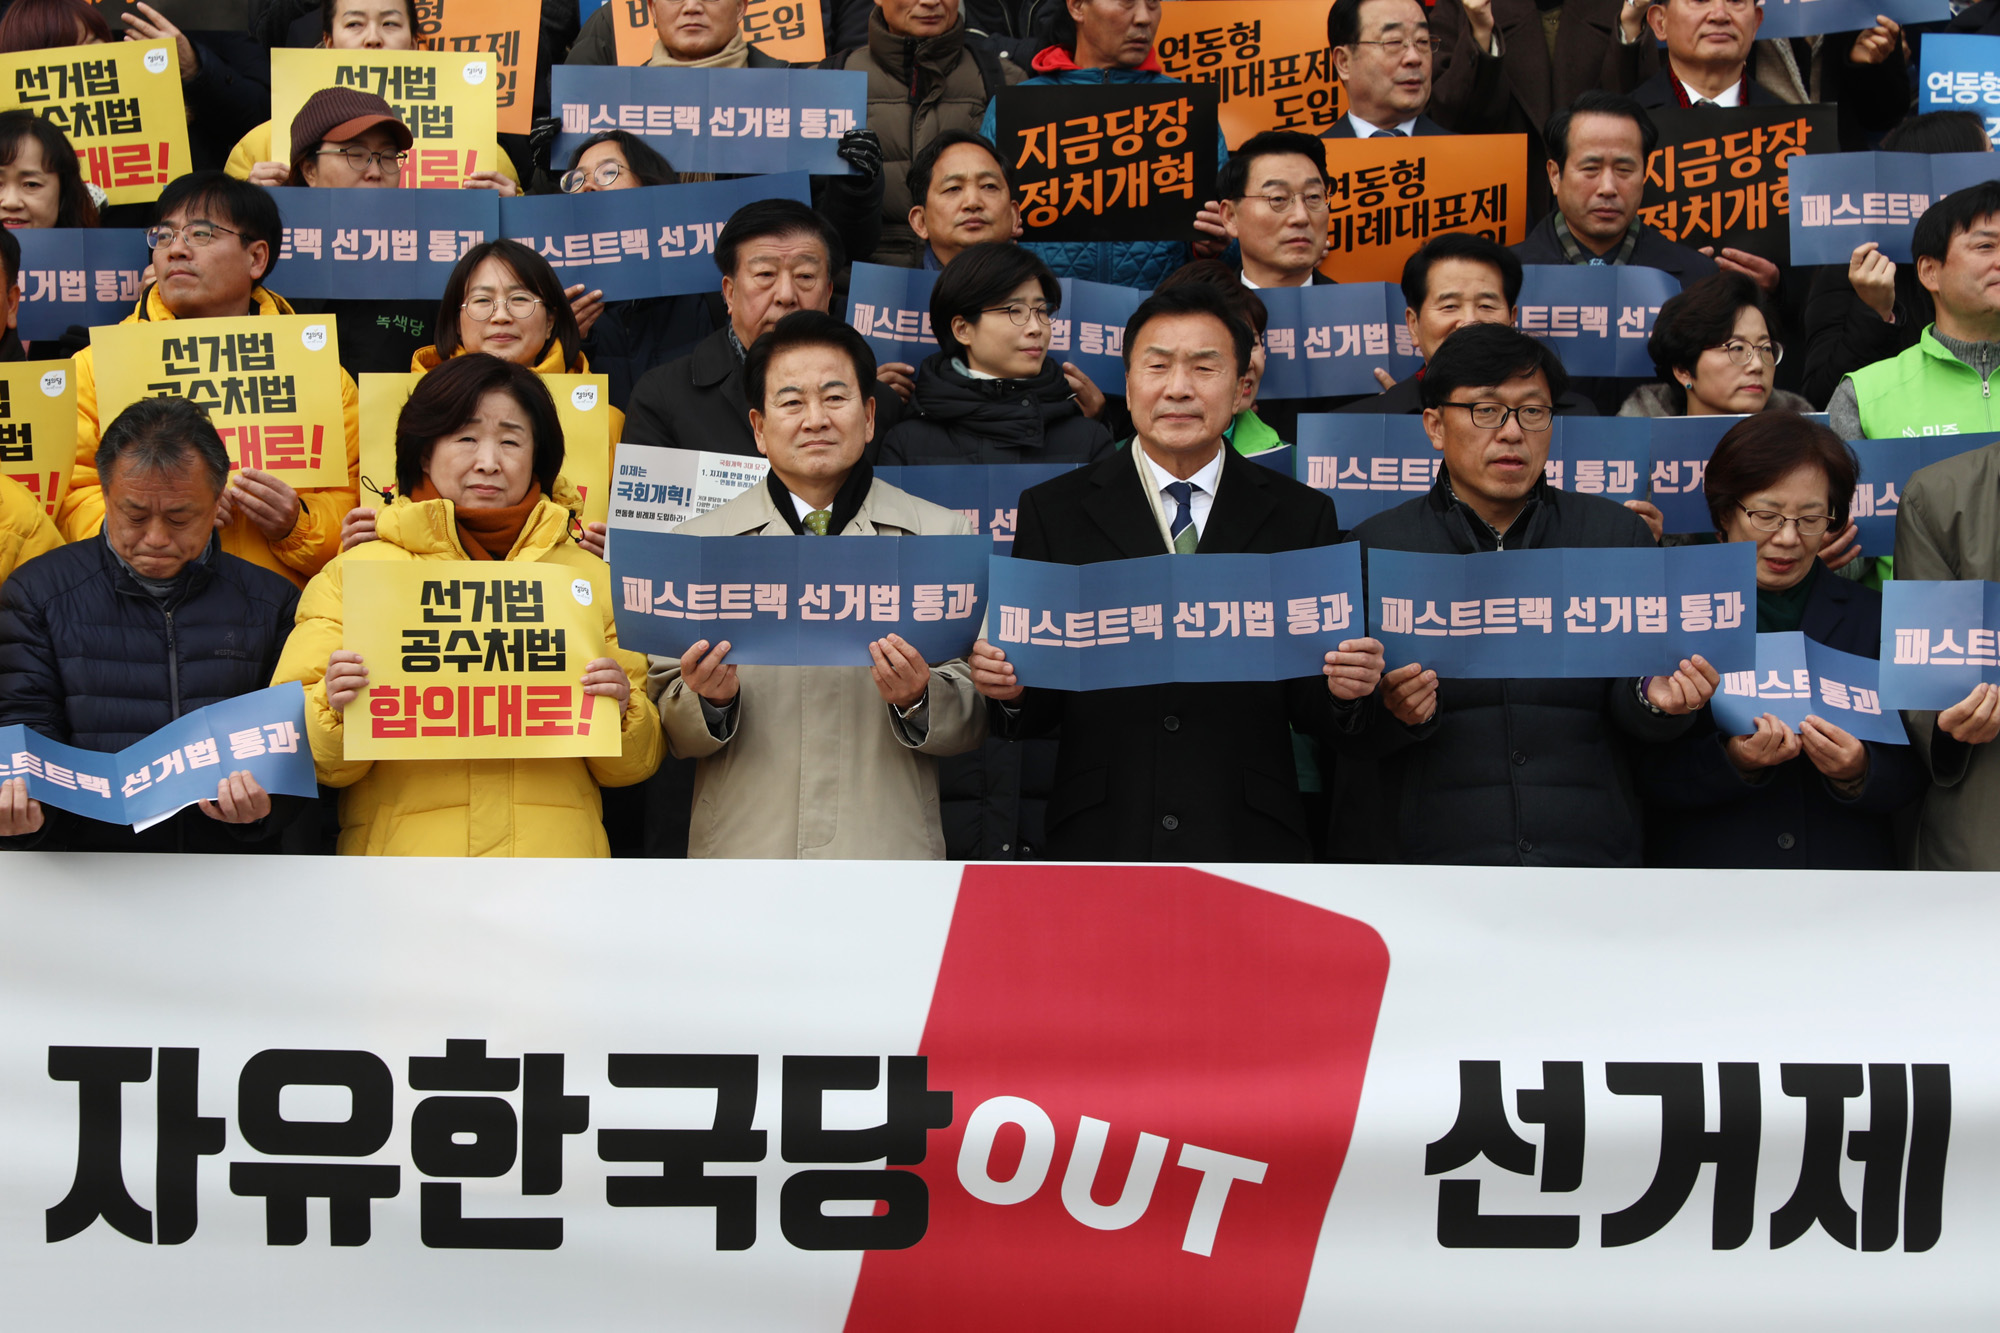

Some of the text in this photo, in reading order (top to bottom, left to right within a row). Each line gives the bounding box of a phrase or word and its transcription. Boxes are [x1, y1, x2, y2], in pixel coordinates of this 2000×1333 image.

[1158, 20, 1261, 72] 연동형
[15, 58, 120, 103] 선거법
[561, 103, 857, 139] 패스트트랙 선거법 통과
[1272, 86, 1339, 131] 도입
[1015, 97, 1194, 170] 지금당장
[1643, 117, 1813, 193] 지금당장
[1018, 151, 1194, 228] 정치개혁
[331, 228, 418, 261] 선거법
[94, 270, 143, 302] 통과
[375, 313, 425, 337] 녹색당
[1303, 322, 1390, 359] 선거법
[161, 332, 275, 376] 선거법
[617, 480, 693, 507] 국회개혁!
[620, 464, 647, 478] 이제는
[1306, 456, 1441, 491] 패스트트
[1574, 460, 1638, 494] 통과
[420, 579, 544, 623] 선거법
[621, 576, 978, 622] 패스트트랙 선거법 통과
[998, 592, 1353, 648] 패스트트랙 선거법 통과
[1380, 591, 1746, 637] 패스트트랙 선거법 통과
[401, 628, 566, 673] 공수처법
[369, 685, 596, 738] 합의대로!
[1819, 676, 1882, 715] 통과
[121, 737, 220, 798] 선거법
[228, 721, 301, 760] 통과
[44, 1038, 1952, 1258] 자유한국당 OUT 선거제
